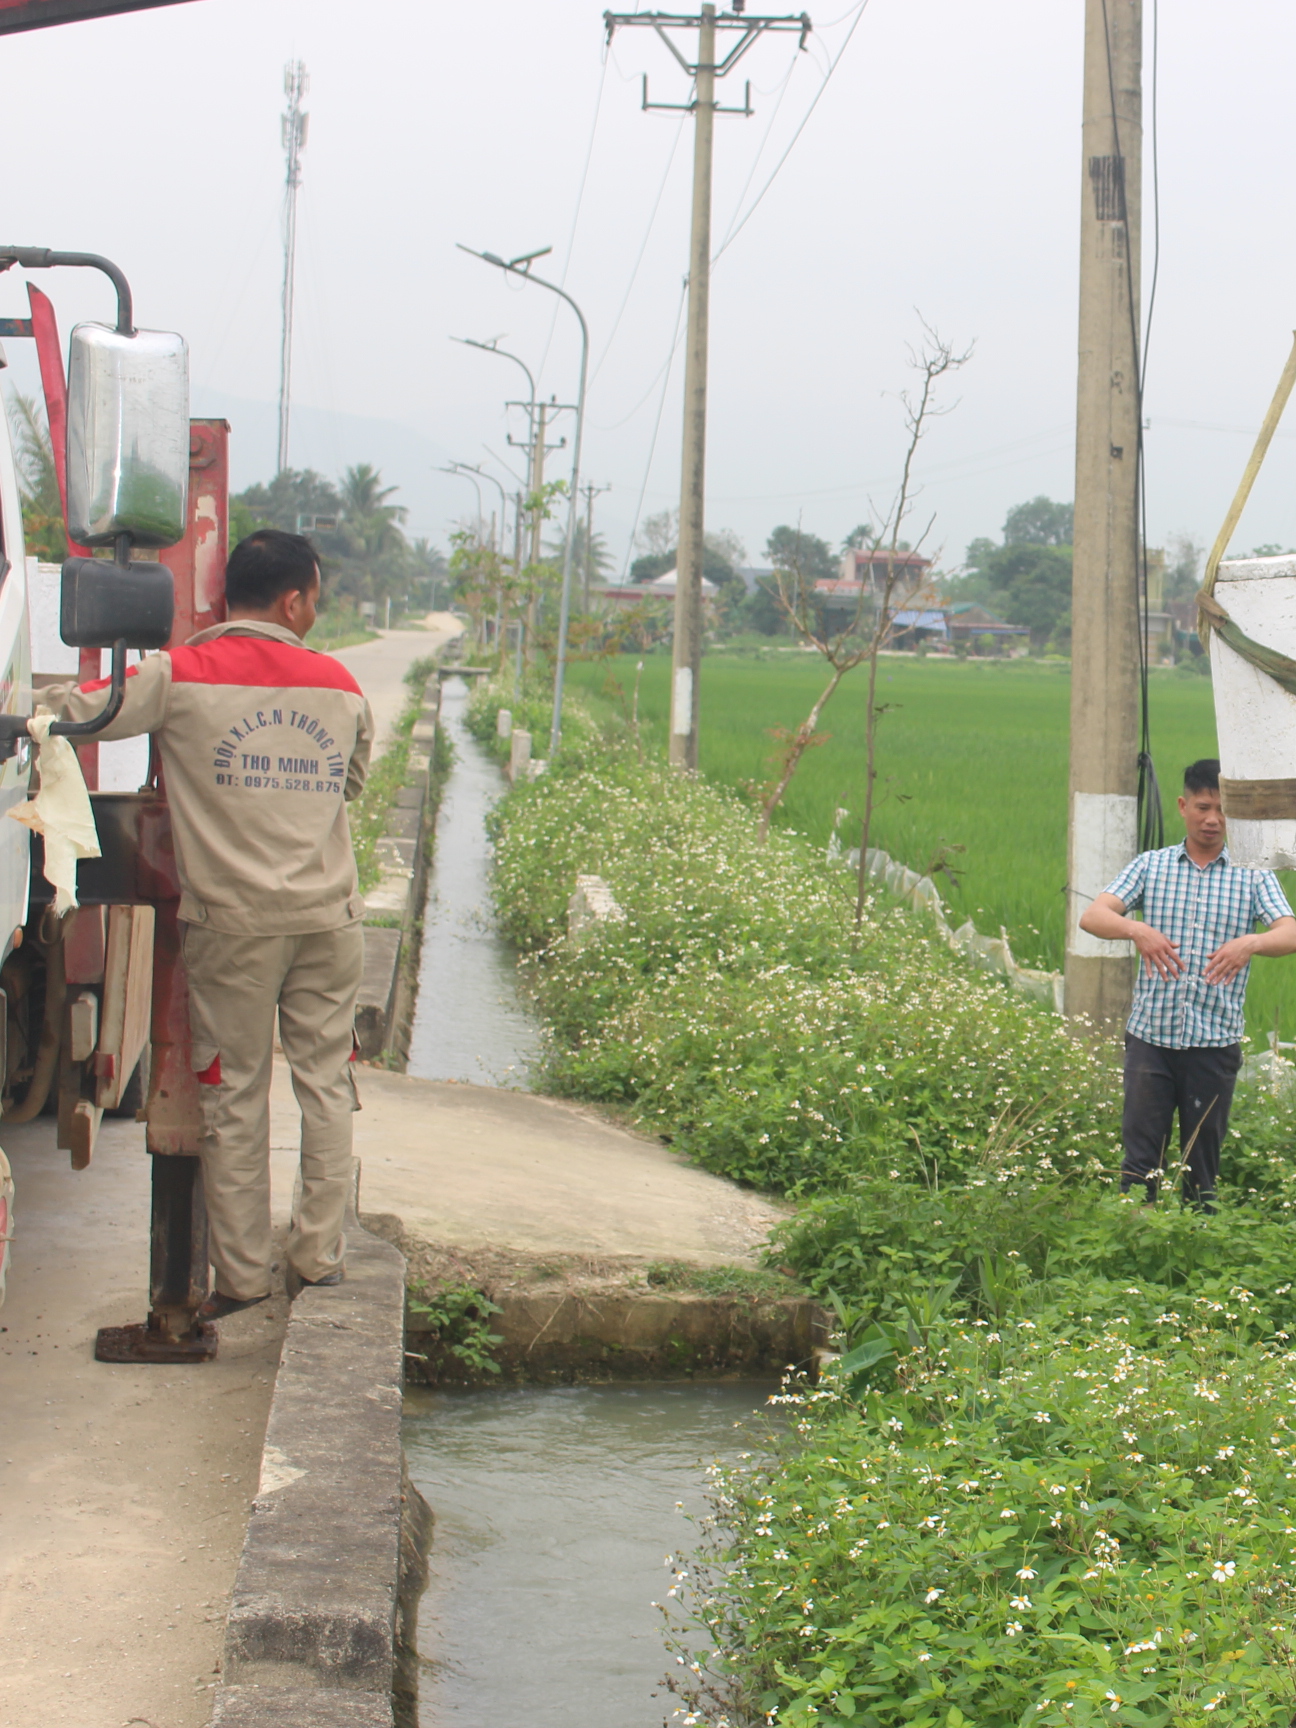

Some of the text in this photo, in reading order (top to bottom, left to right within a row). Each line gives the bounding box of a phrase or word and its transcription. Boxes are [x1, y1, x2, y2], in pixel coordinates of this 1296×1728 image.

[212, 709, 344, 777] ĐỘI X.L.C.N THÔNG TIN
[241, 754, 319, 775] THỌ MINH
[216, 773, 340, 793] ĐT: 0975.528.675
